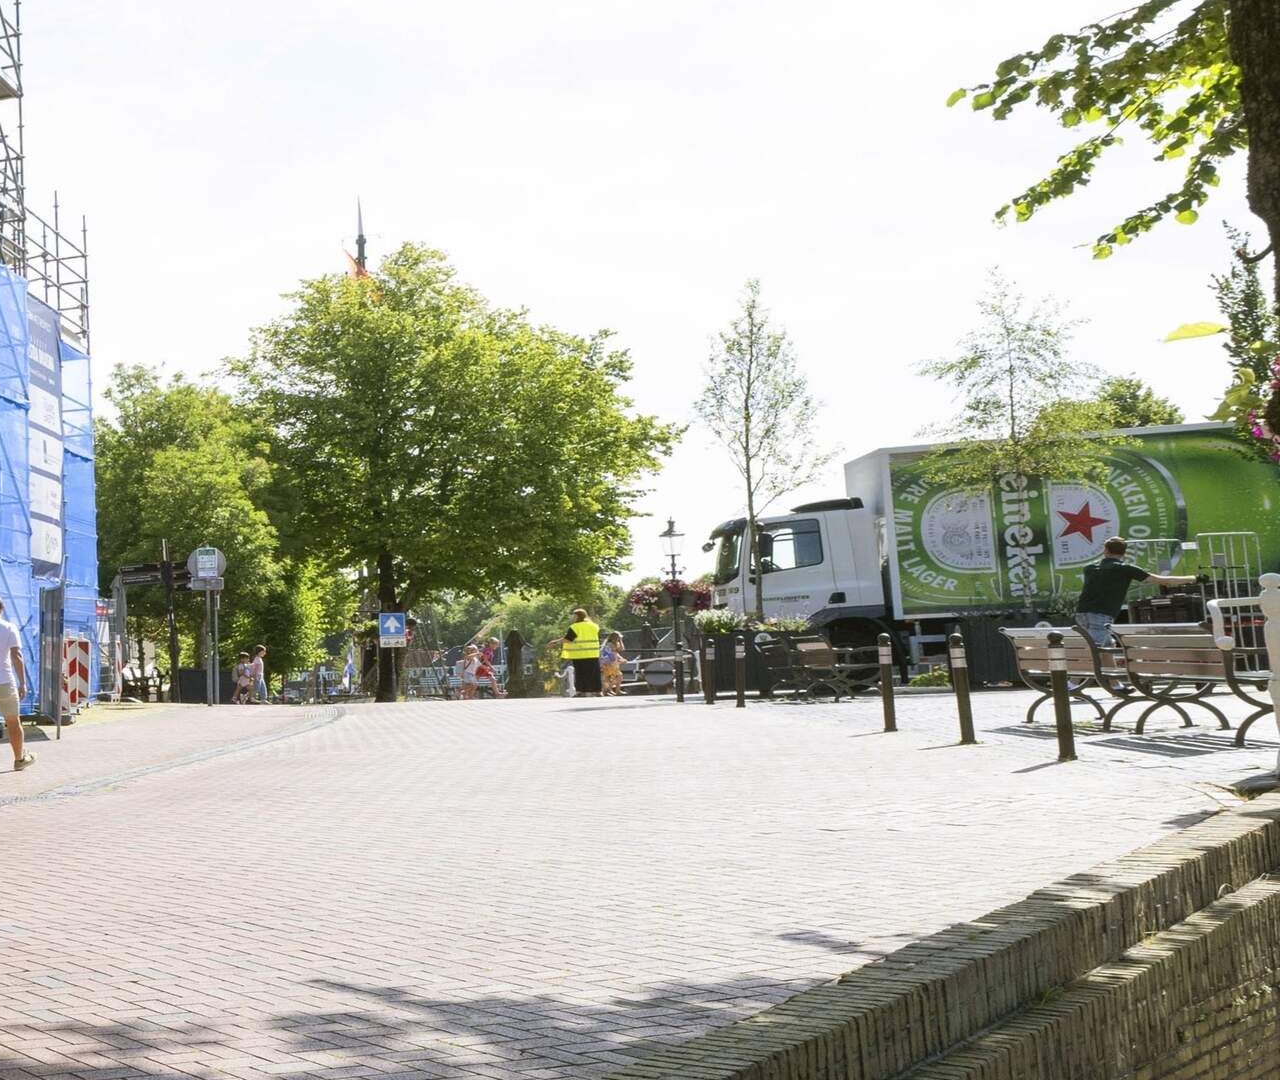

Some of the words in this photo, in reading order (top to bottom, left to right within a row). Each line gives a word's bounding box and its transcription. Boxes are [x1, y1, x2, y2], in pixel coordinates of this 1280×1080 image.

[893, 508, 917, 551] MALT
[999, 472, 1044, 598] eineken
[901, 557, 959, 592] LAGER
